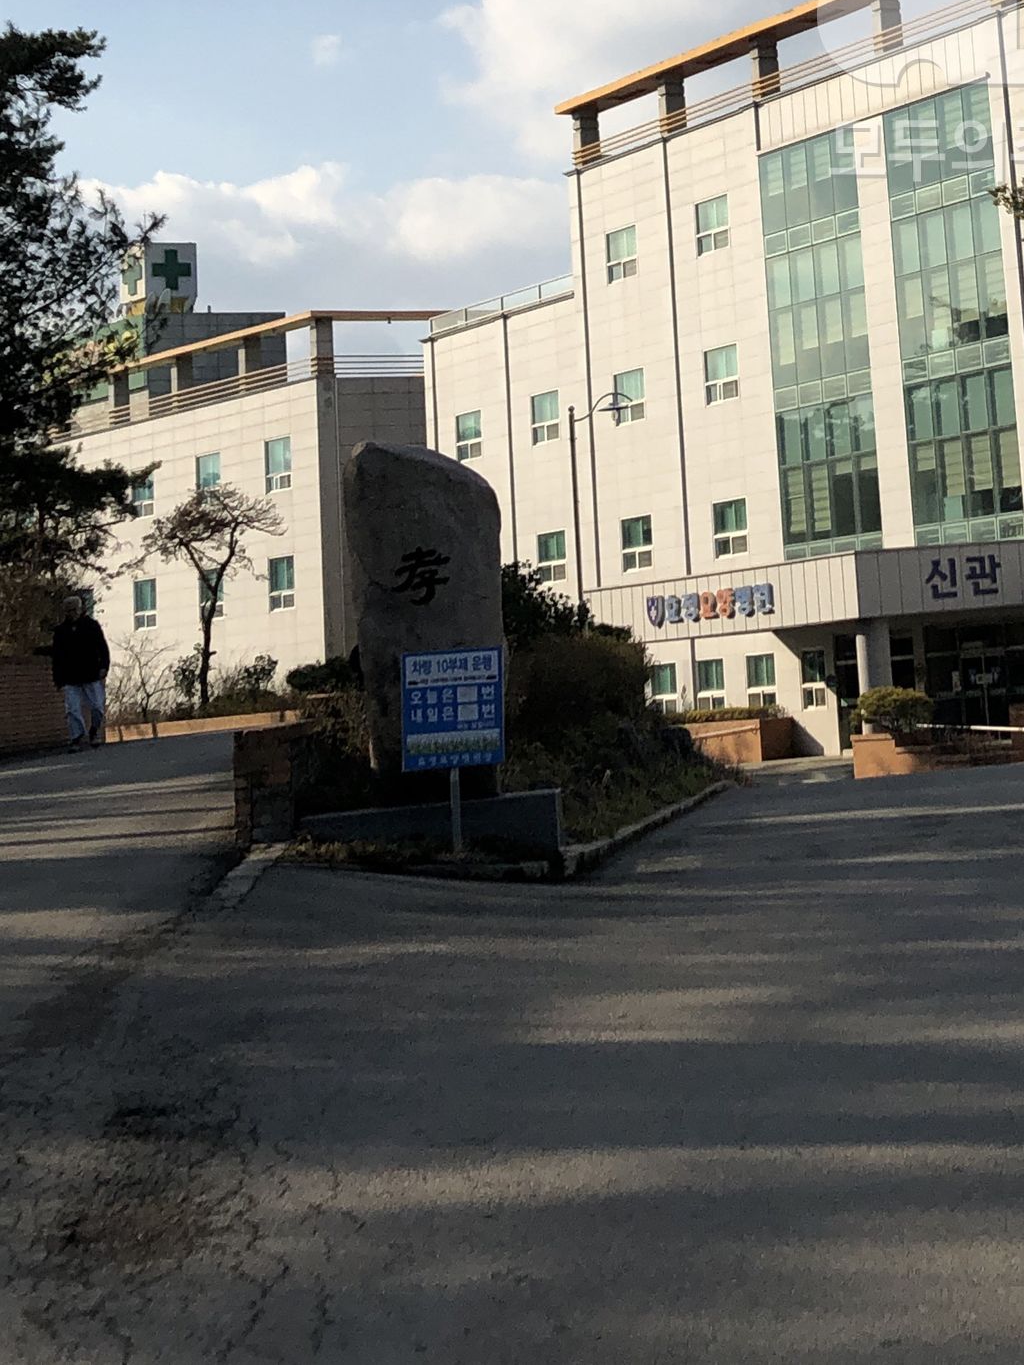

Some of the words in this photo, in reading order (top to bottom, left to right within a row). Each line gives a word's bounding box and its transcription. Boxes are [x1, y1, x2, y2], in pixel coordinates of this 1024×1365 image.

[393, 545, 452, 607] 孝
[924, 553, 1002, 601] 신관
[665, 583, 775, 623] 효정요양병원
